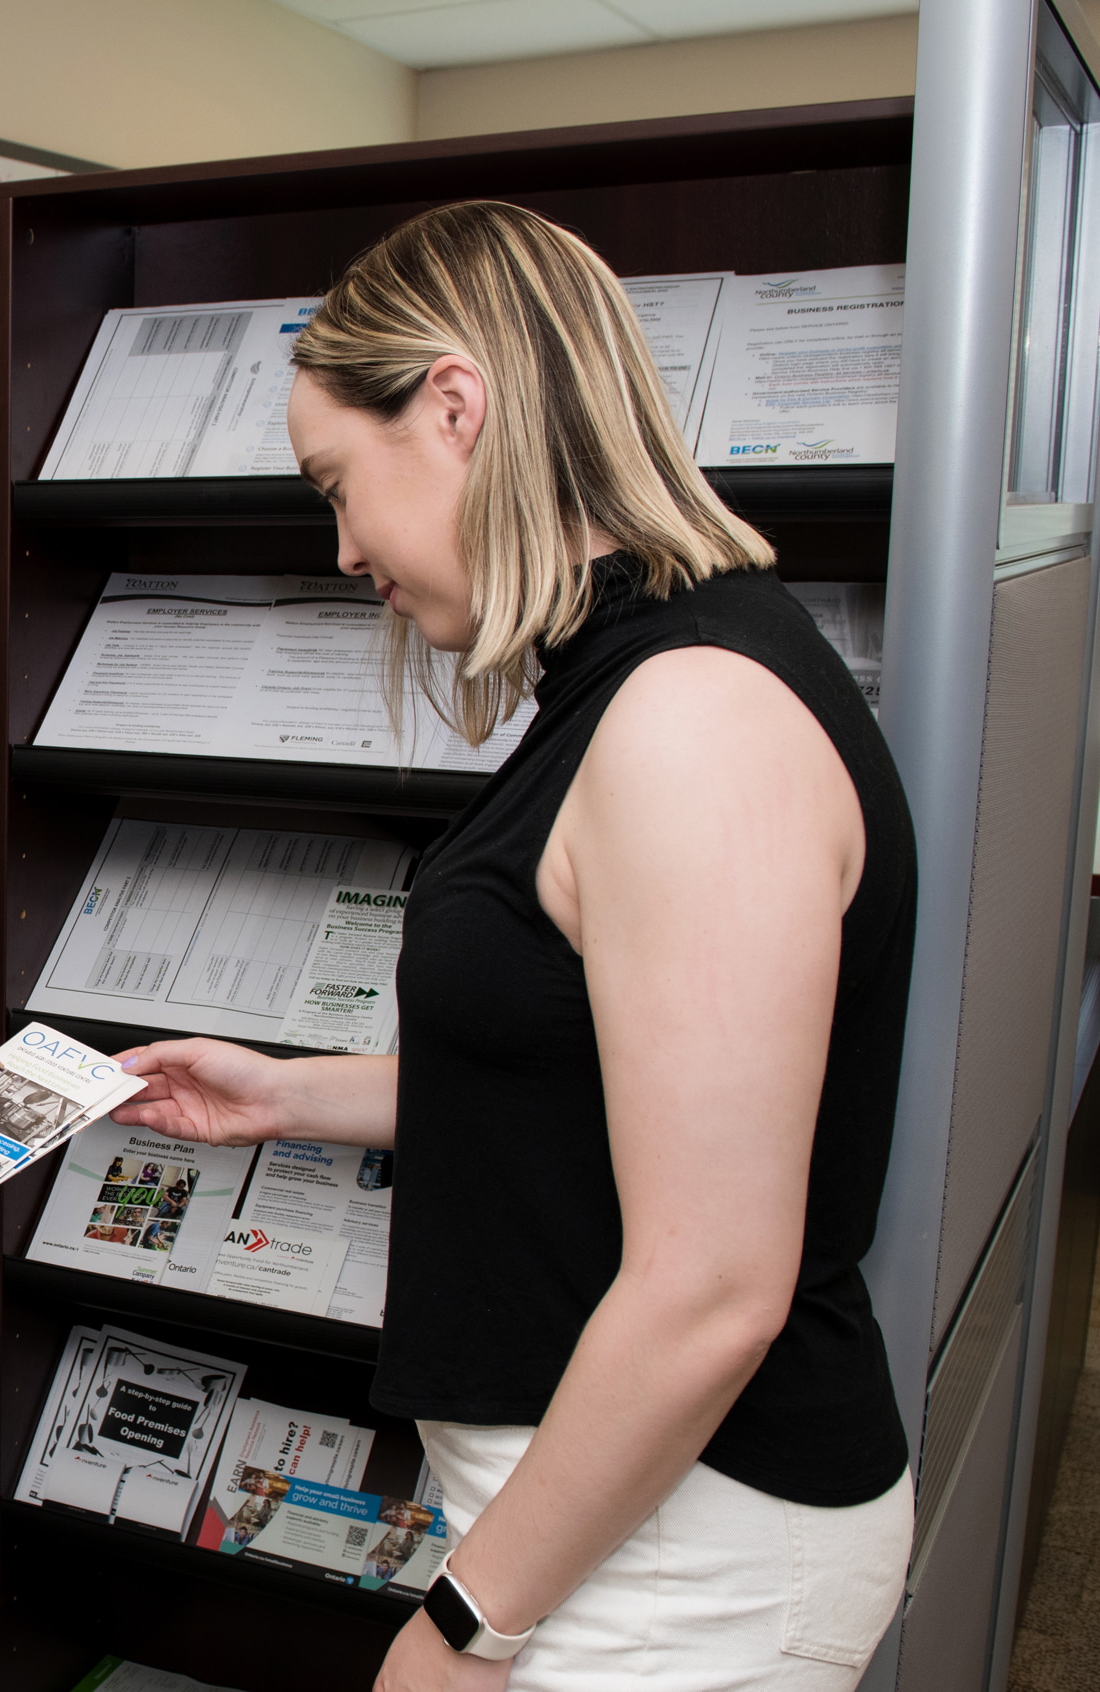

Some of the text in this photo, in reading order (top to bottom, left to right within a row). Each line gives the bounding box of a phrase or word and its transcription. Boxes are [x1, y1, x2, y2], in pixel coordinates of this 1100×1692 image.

[298, 308, 316, 316] BE
[787, 305, 834, 315] BUSINESS
[729, 445, 778, 455] BECN
[190, 608, 228, 616] SERVICES
[317, 611, 366, 619] EMPLOYER
[291, 735, 324, 743] FLEMING
[83, 887, 103, 915] BECN
[336, 890, 408, 909] IMAGIN
[369, 911, 393, 919] business
[309, 988, 354, 999] FORWARD
[324, 983, 358, 992] FASTER
[321, 1001, 360, 1010] BUSINESSES
[321, 1006, 354, 1014] SMARTER!
[22, 1031, 115, 1080] OAFVC
[129, 1136, 195, 1154] Business Plan
[276, 1139, 323, 1155] Financing
[147, 1151, 169, 1159] business
[272, 1149, 334, 1167] and advising
[269, 1161, 316, 1173] Services designed
[273, 1167, 293, 1176] protect
[306, 1171, 319, 1179] cash
[278, 1173, 288, 1181] help
[315, 1179, 339, 1188] business
[269, 1237, 313, 1257] trade
[132, 1269, 156, 1280] Company
[136, 1265, 158, 1274] Summer
[168, 1263, 197, 1275] Ontario
[127, 1388, 171, 1406] step-by-step
[171, 1401, 193, 1411] guide
[148, 1404, 157, 1412] to
[108, 1406, 187, 1438] Food Premises
[120, 1426, 165, 1448] Opening
[273, 1421, 299, 1472] to hire?
[288, 1424, 312, 1476] can help!
[226, 1459, 248, 1494] EARN
[294, 1484, 366, 1506] Help your small business
[292, 1492, 369, 1516] grow and thrive
[324, 1572, 346, 1583] Ontario
